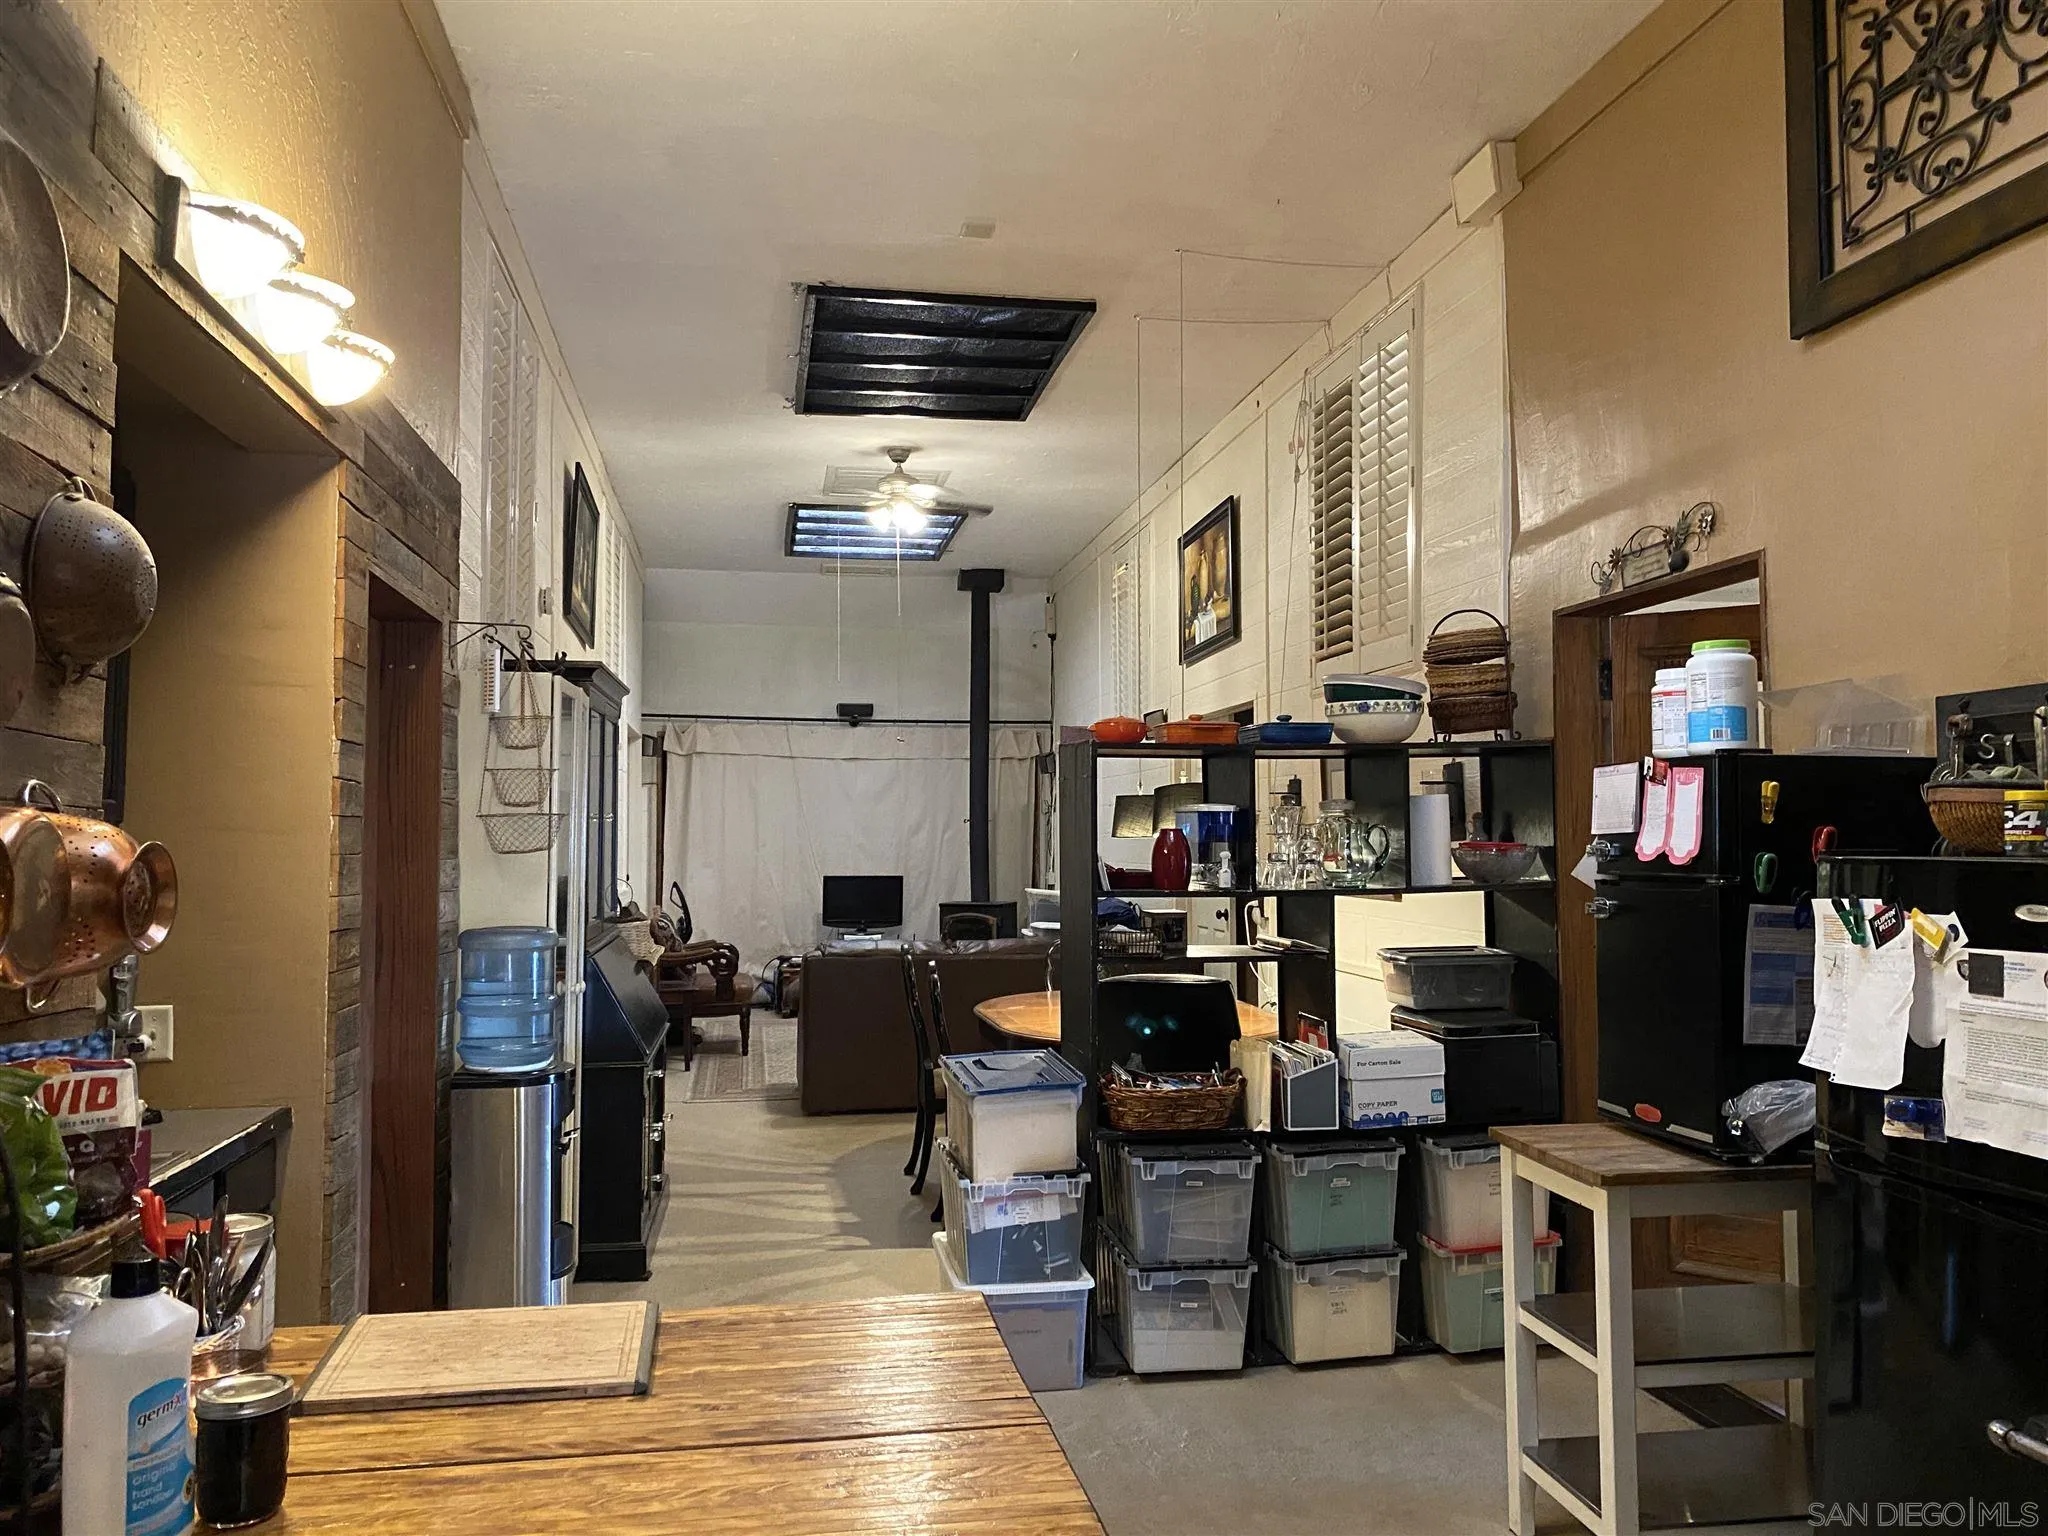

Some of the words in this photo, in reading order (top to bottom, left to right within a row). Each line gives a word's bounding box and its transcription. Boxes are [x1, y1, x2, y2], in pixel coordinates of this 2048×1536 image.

[1879, 917, 1897, 932] PIZZA
[41, 1077, 118, 1117] VID
[132, 1480, 163, 1500] hand
